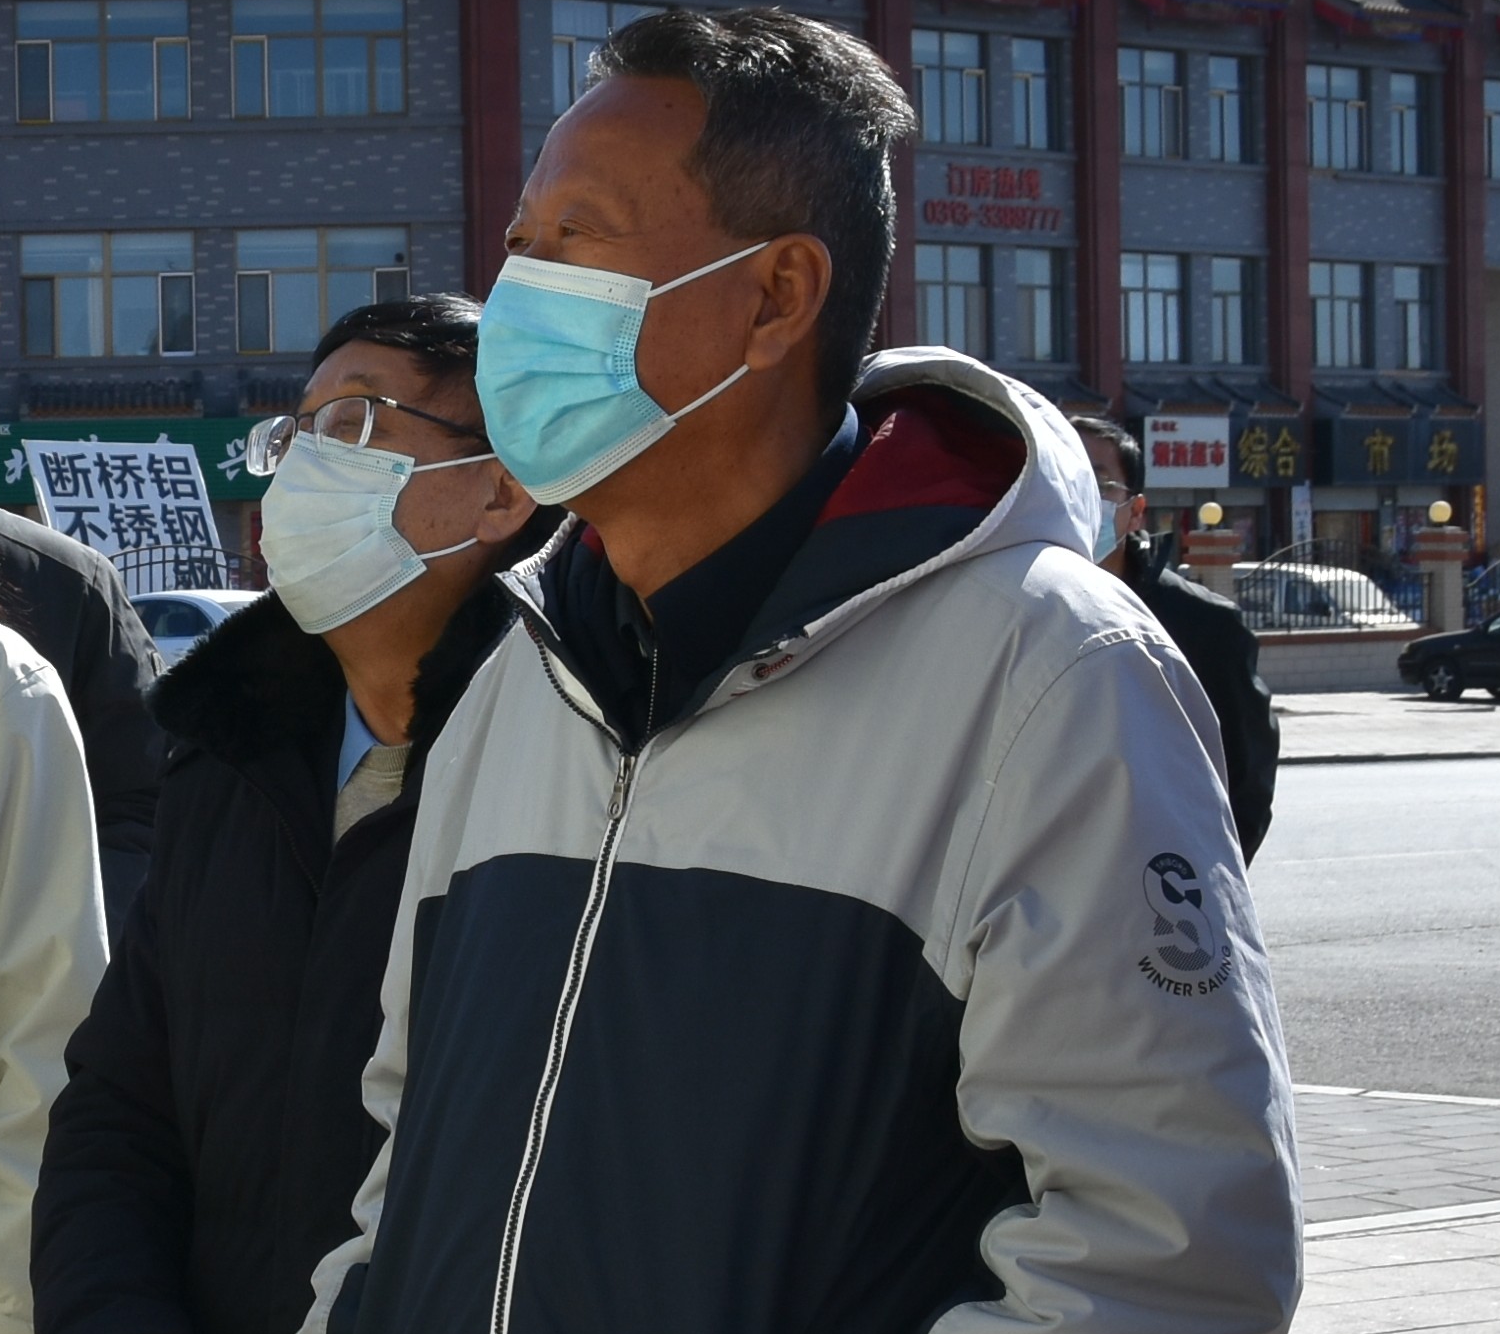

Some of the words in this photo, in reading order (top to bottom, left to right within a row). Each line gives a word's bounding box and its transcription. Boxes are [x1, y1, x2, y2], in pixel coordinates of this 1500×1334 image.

[39, 451, 201, 501] 断桥铝
[54, 503, 212, 550] 不锈钢
[1138, 955, 1193, 997] WINTER
[1197, 945, 1233, 996] SAILING
